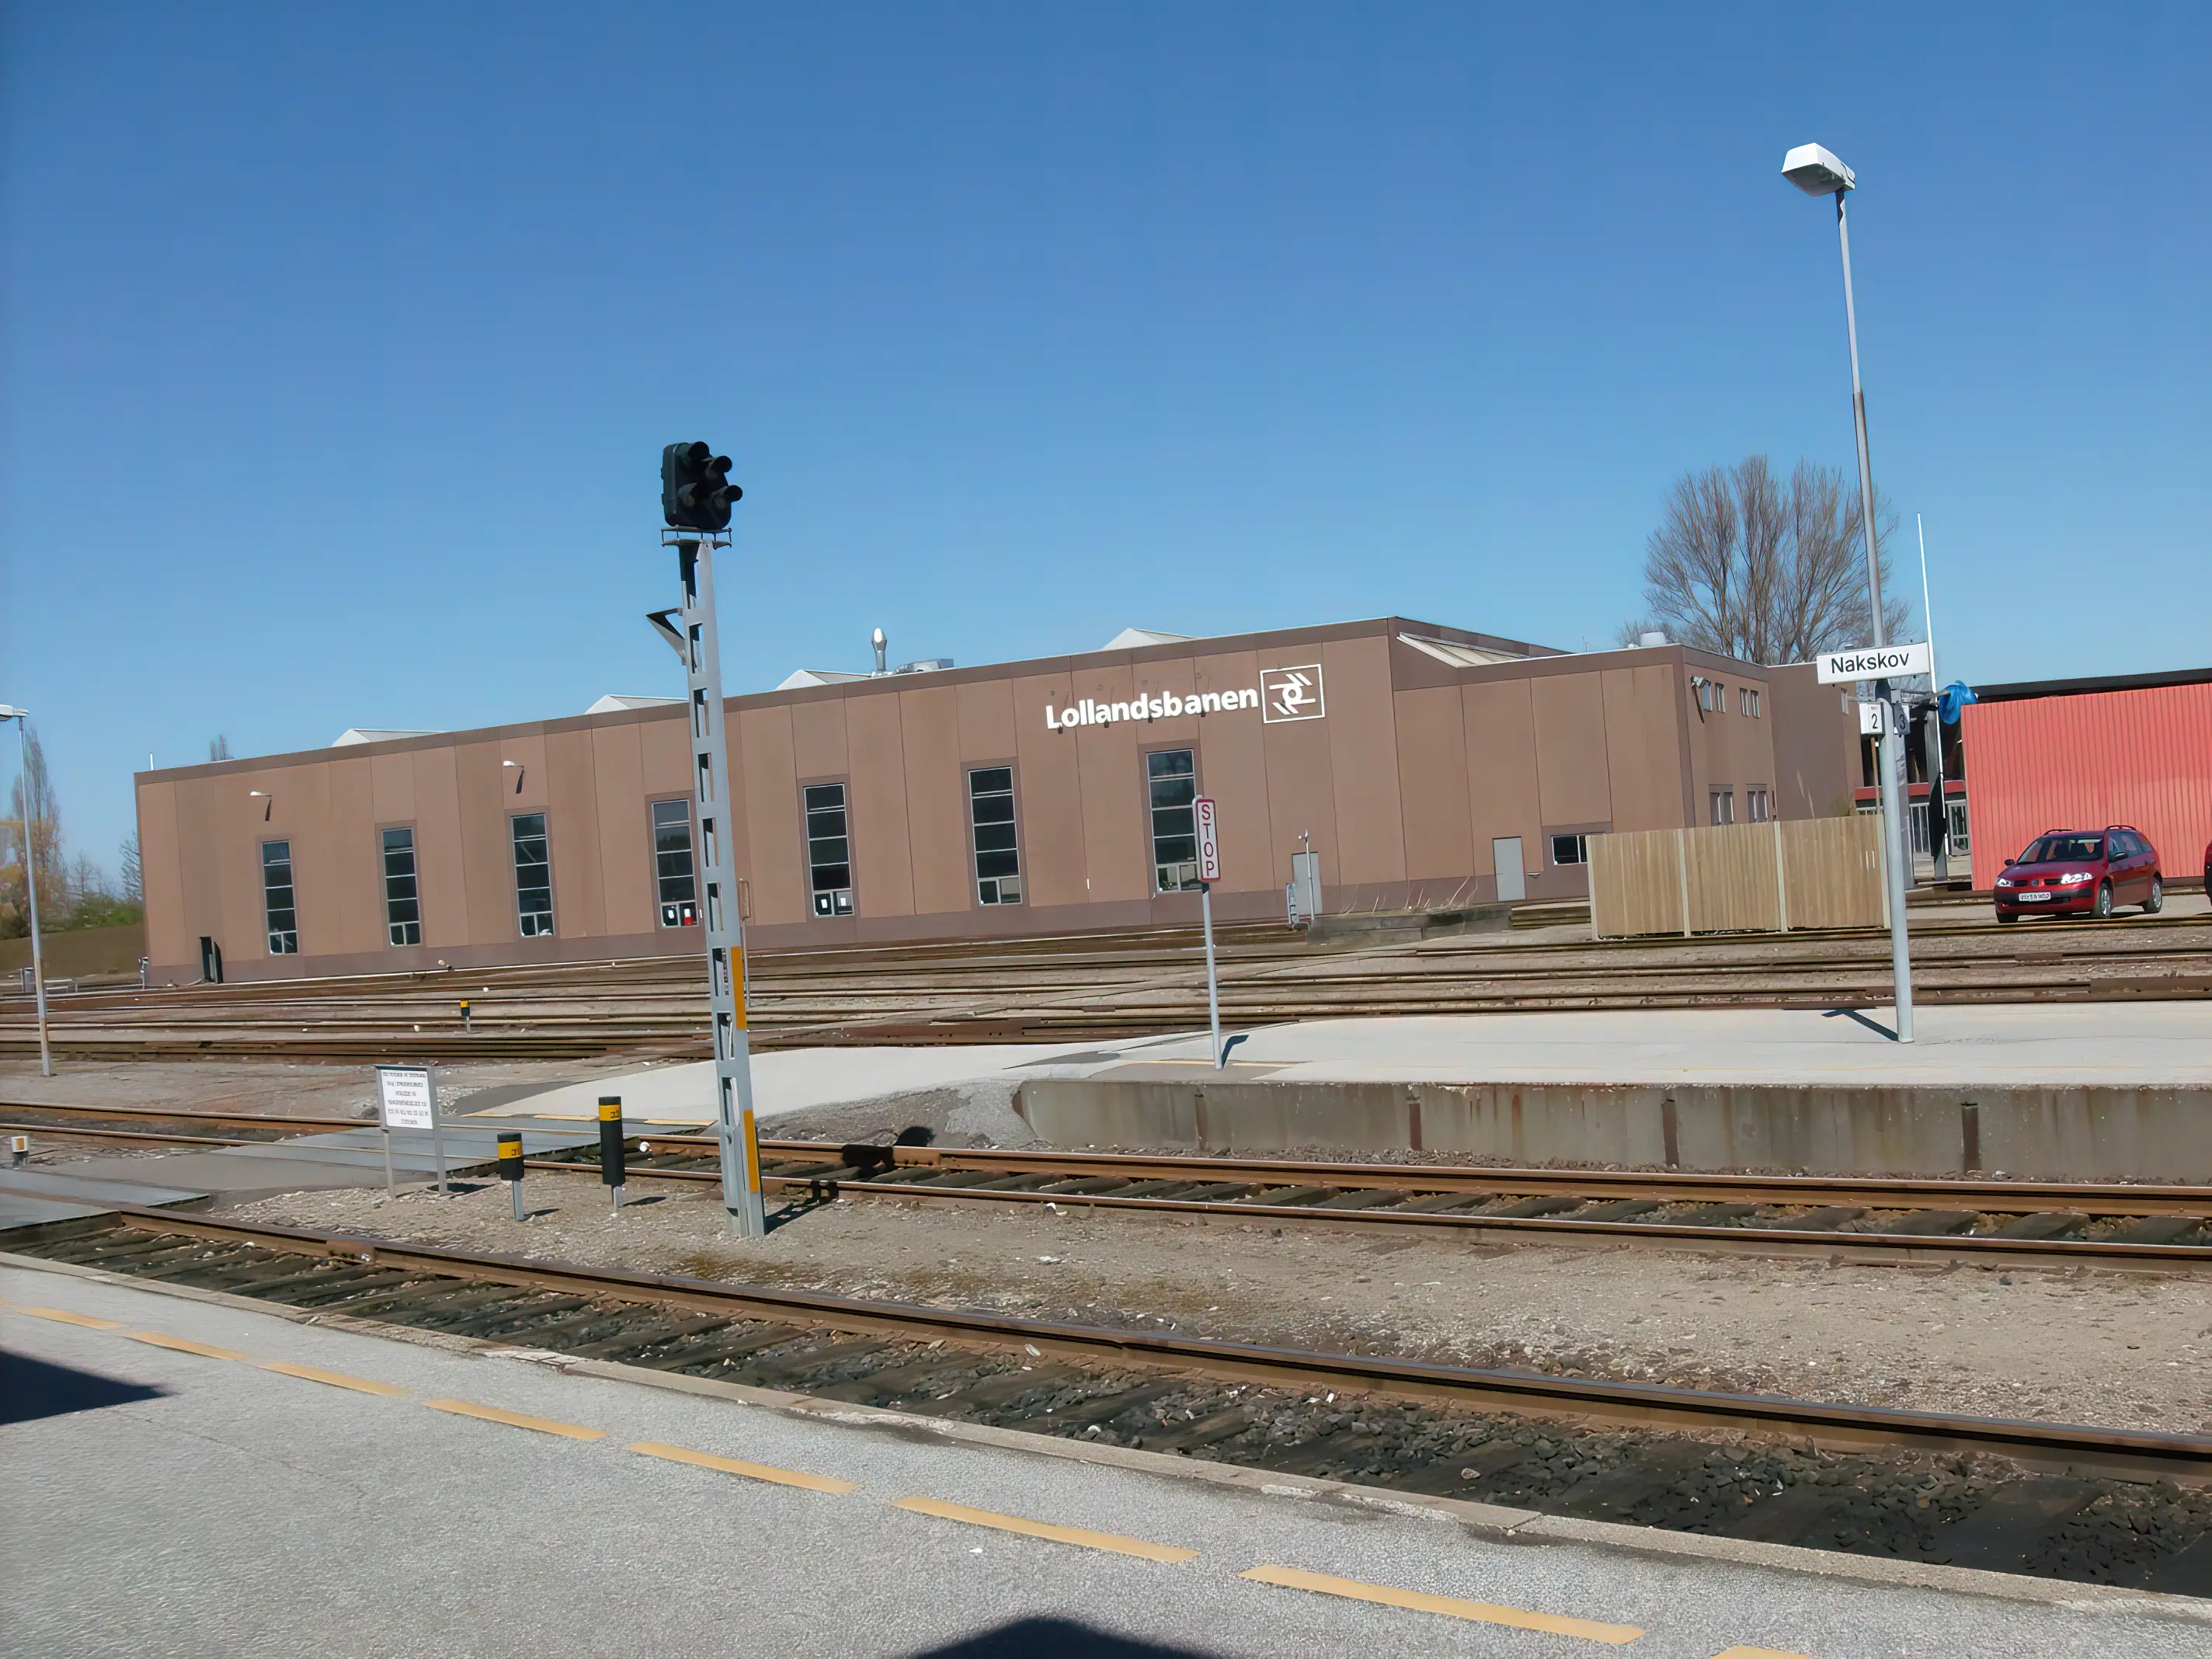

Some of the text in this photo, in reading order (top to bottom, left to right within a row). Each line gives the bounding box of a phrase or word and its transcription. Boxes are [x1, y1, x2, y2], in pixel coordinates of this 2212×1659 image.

[1831, 652, 1910, 674] Nakskov
[1045, 687, 1259, 729] Lollandsbanen
[1871, 713, 1878, 729] 2
[1899, 714, 1906, 729] 3
[1201, 804, 1215, 877] STOP
